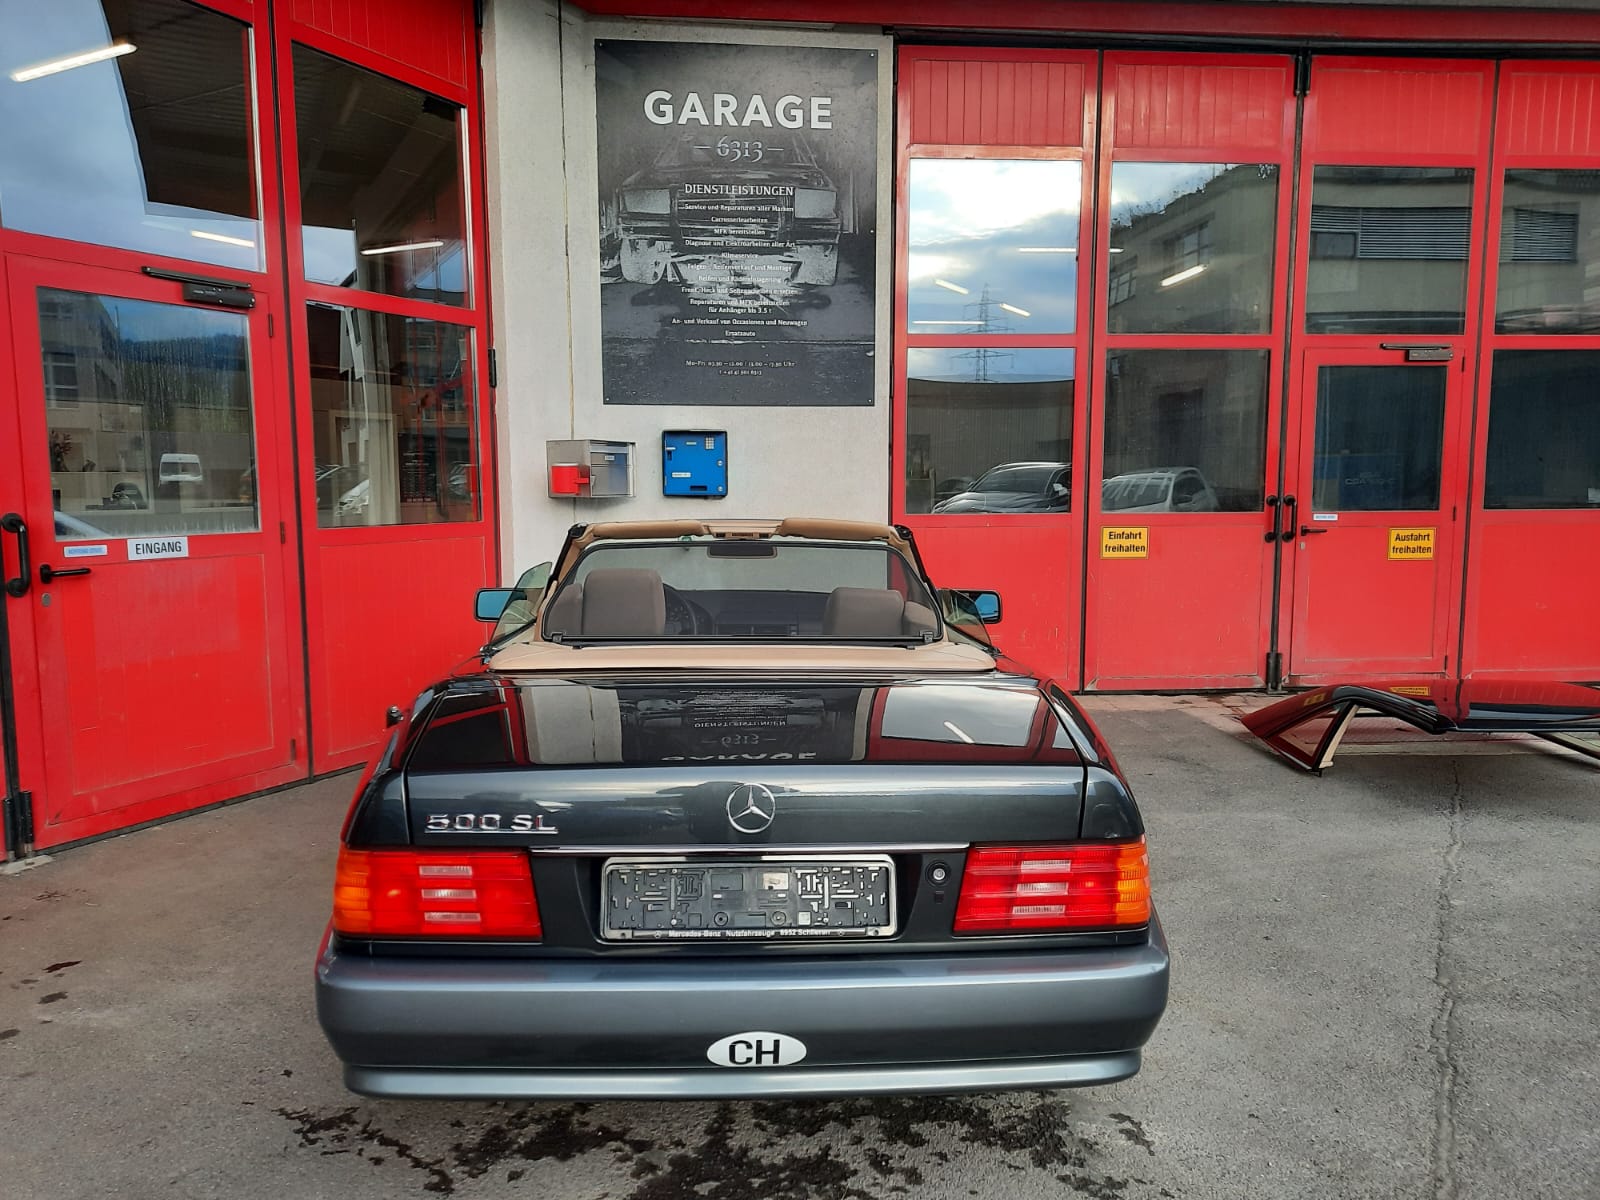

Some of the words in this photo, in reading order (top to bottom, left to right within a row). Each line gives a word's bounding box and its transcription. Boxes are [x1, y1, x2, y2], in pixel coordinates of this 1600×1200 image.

[643, 90, 833, 130] GARAGE
[715, 135, 763, 162] 6313
[684, 183, 794, 196] DIENSTLEISTUNGEN
[720, 204, 756, 212] Reparaturen
[685, 240, 712, 248] Diagnose
[766, 264, 792, 272] Montage
[689, 298, 726, 306] Reparaturen
[718, 306, 747, 314] Anhänger
[777, 319, 808, 327] Neuwagen
[1108, 531, 1142, 540] Einfahrt
[1395, 533, 1430, 542] Ausfahrt
[135, 541, 182, 555] EINGANG
[1104, 543, 1146, 552] freihalten
[1392, 545, 1432, 554] freihalten
[426, 813, 502, 831] 500
[510, 813, 557, 831] SL
[668, 929, 722, 938] Mercedes-Benz
[725, 928, 776, 938] Nutzfahrzeuge
[728, 1039, 781, 1066] CH
